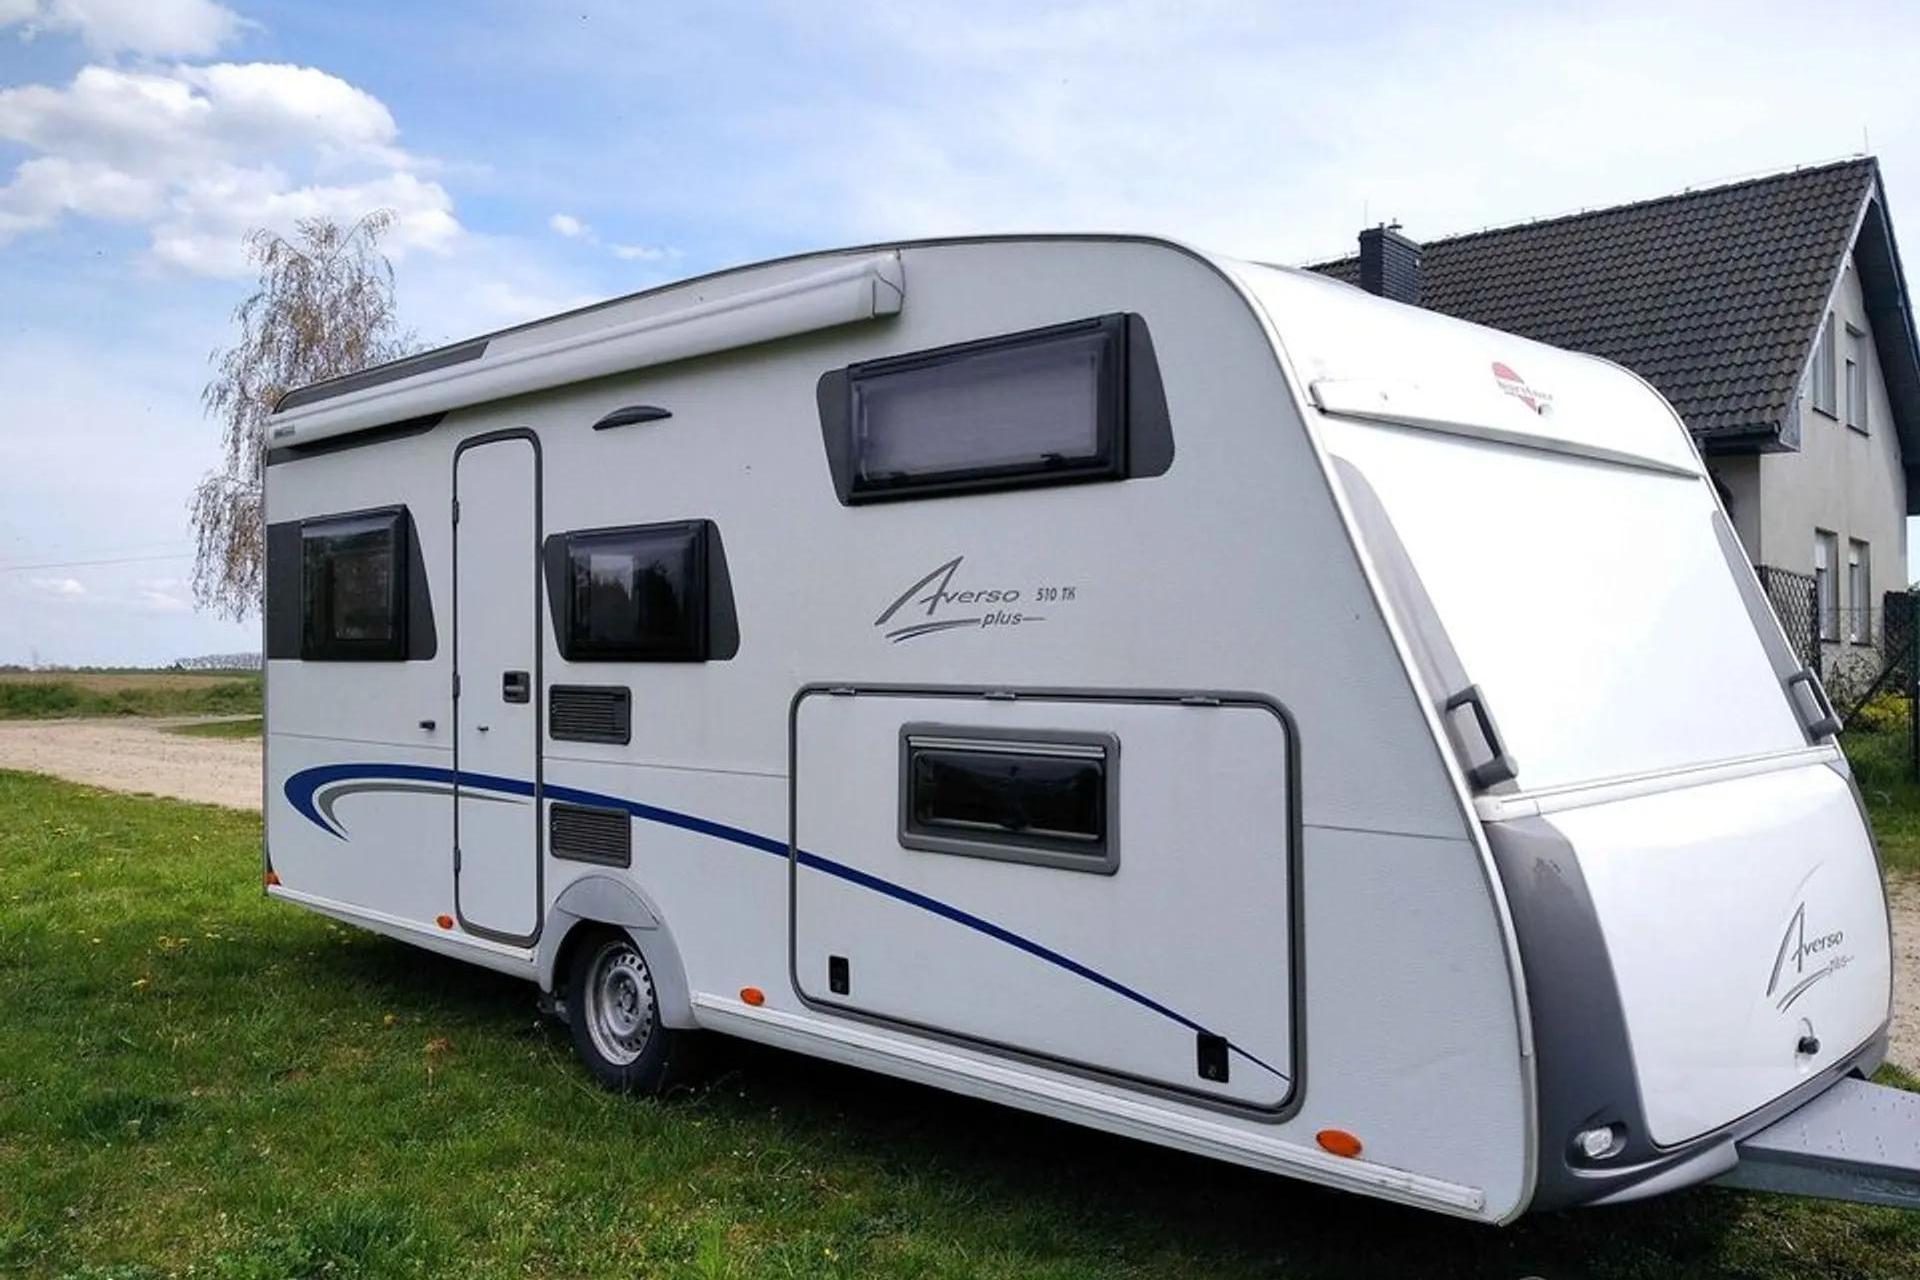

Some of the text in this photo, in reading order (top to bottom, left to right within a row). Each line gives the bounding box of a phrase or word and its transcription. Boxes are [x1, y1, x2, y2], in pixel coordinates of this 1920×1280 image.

[874, 555, 1020, 626] Averso
[1035, 587, 1057, 602] 510
[981, 610, 1022, 628] plus
[1766, 901, 1844, 997] Averso
